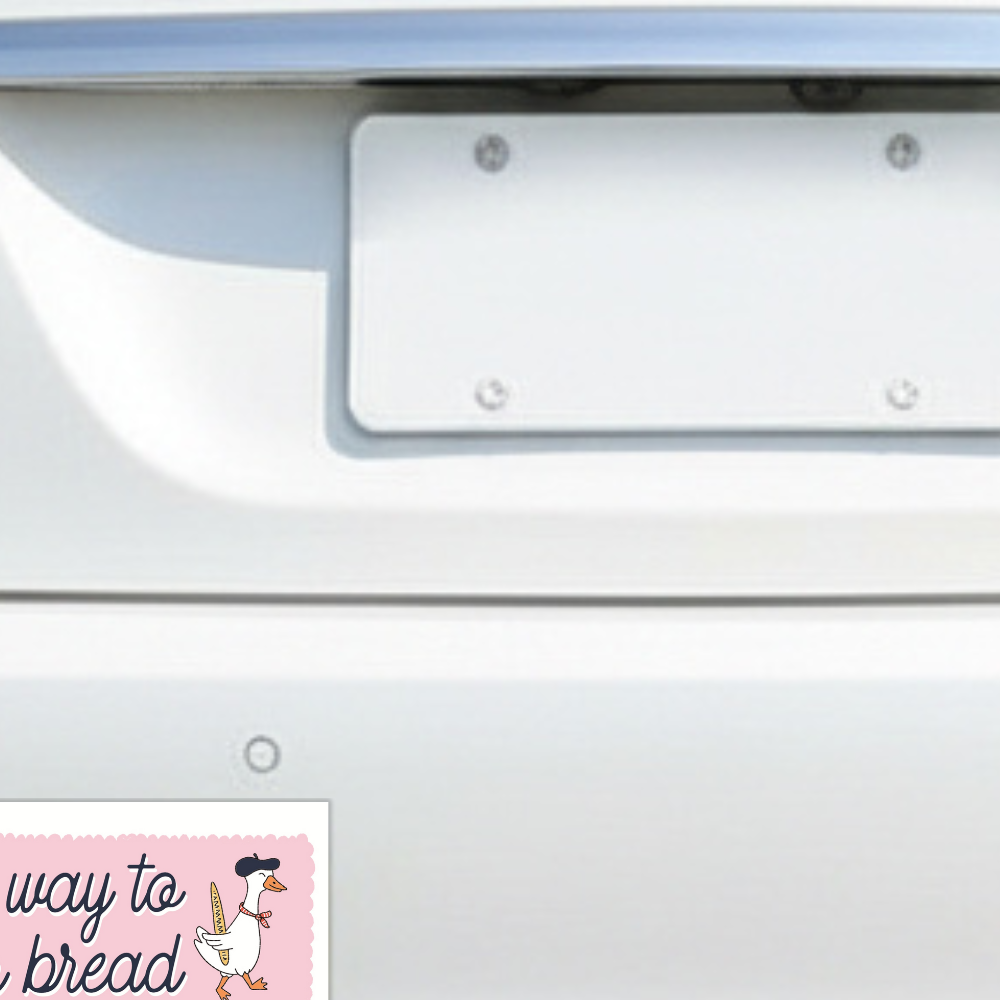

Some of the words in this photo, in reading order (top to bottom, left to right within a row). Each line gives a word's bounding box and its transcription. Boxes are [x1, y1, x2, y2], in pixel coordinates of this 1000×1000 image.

[5, 872, 117, 944] way
[127, 853, 187, 913] to
[21, 933, 187, 994] bread
